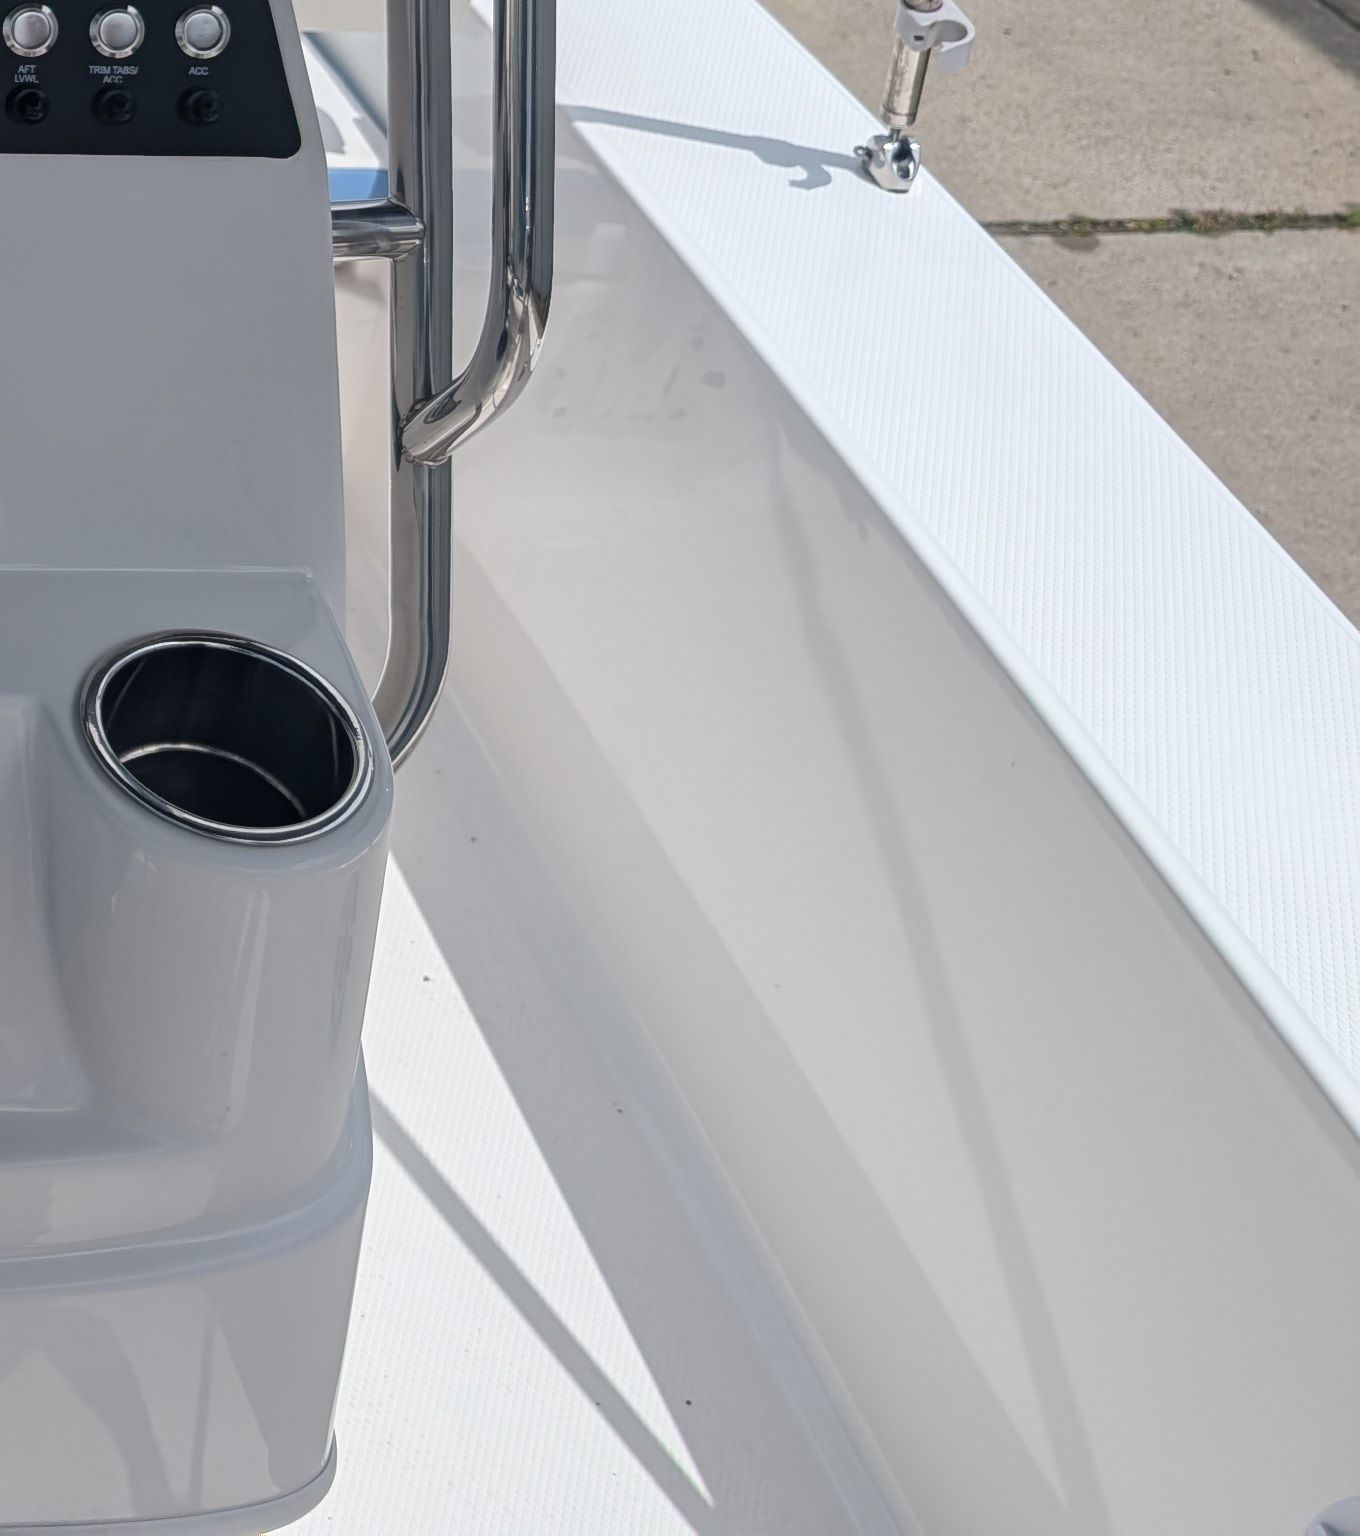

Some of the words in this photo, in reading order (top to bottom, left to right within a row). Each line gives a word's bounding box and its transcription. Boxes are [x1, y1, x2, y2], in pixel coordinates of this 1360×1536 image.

[17, 65, 36, 73] AFT
[88, 65, 112, 74] TRIM
[113, 65, 138, 74] TABS/
[189, 67, 208, 75] ACC
[14, 74, 39, 83] LVWL
[102, 75, 123, 84] ACC
